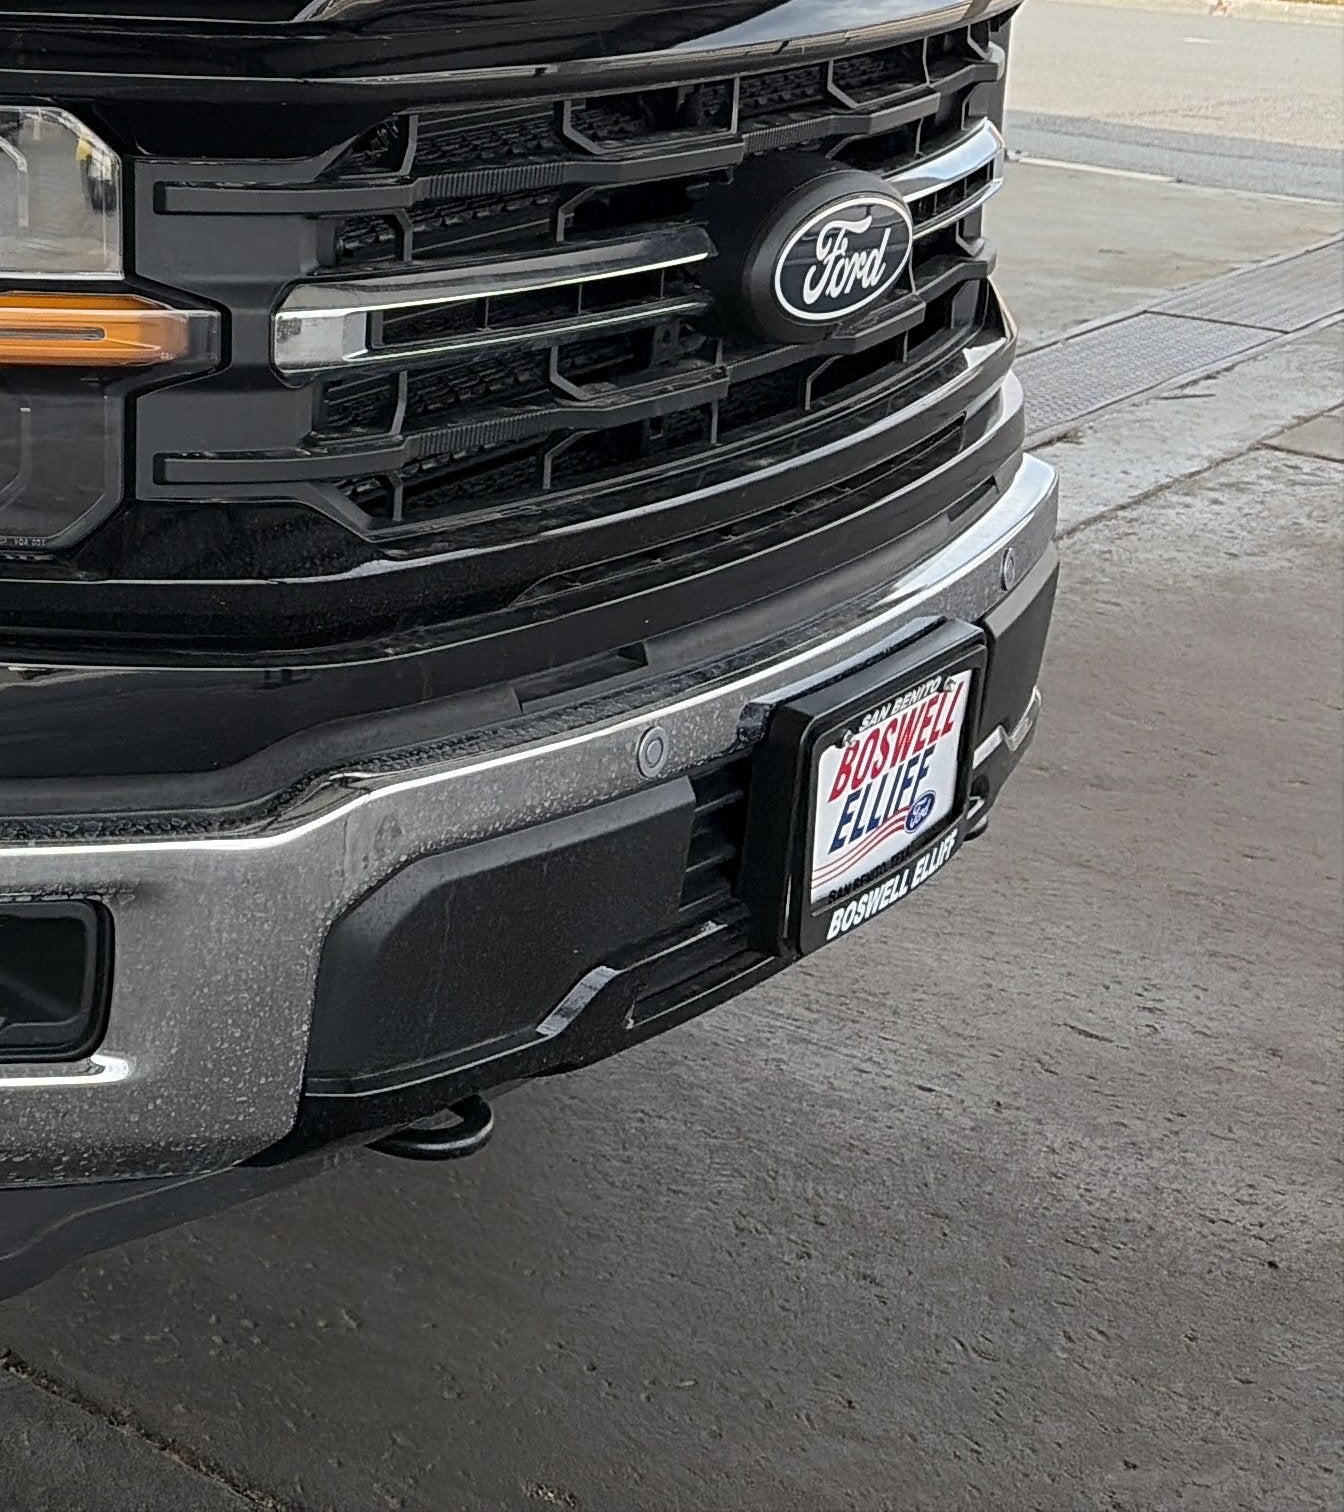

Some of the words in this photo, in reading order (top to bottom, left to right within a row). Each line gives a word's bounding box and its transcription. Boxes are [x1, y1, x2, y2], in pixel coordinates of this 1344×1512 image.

[802, 215, 892, 305] Ford
[827, 681, 965, 803] BOSWELL
[859, 705, 888, 732] SAN
[893, 675, 941, 719] BENITO
[828, 744, 936, 855] ELLIFF
[826, 872, 910, 941] BOSWELL
[910, 828, 959, 891] ELLIFF
